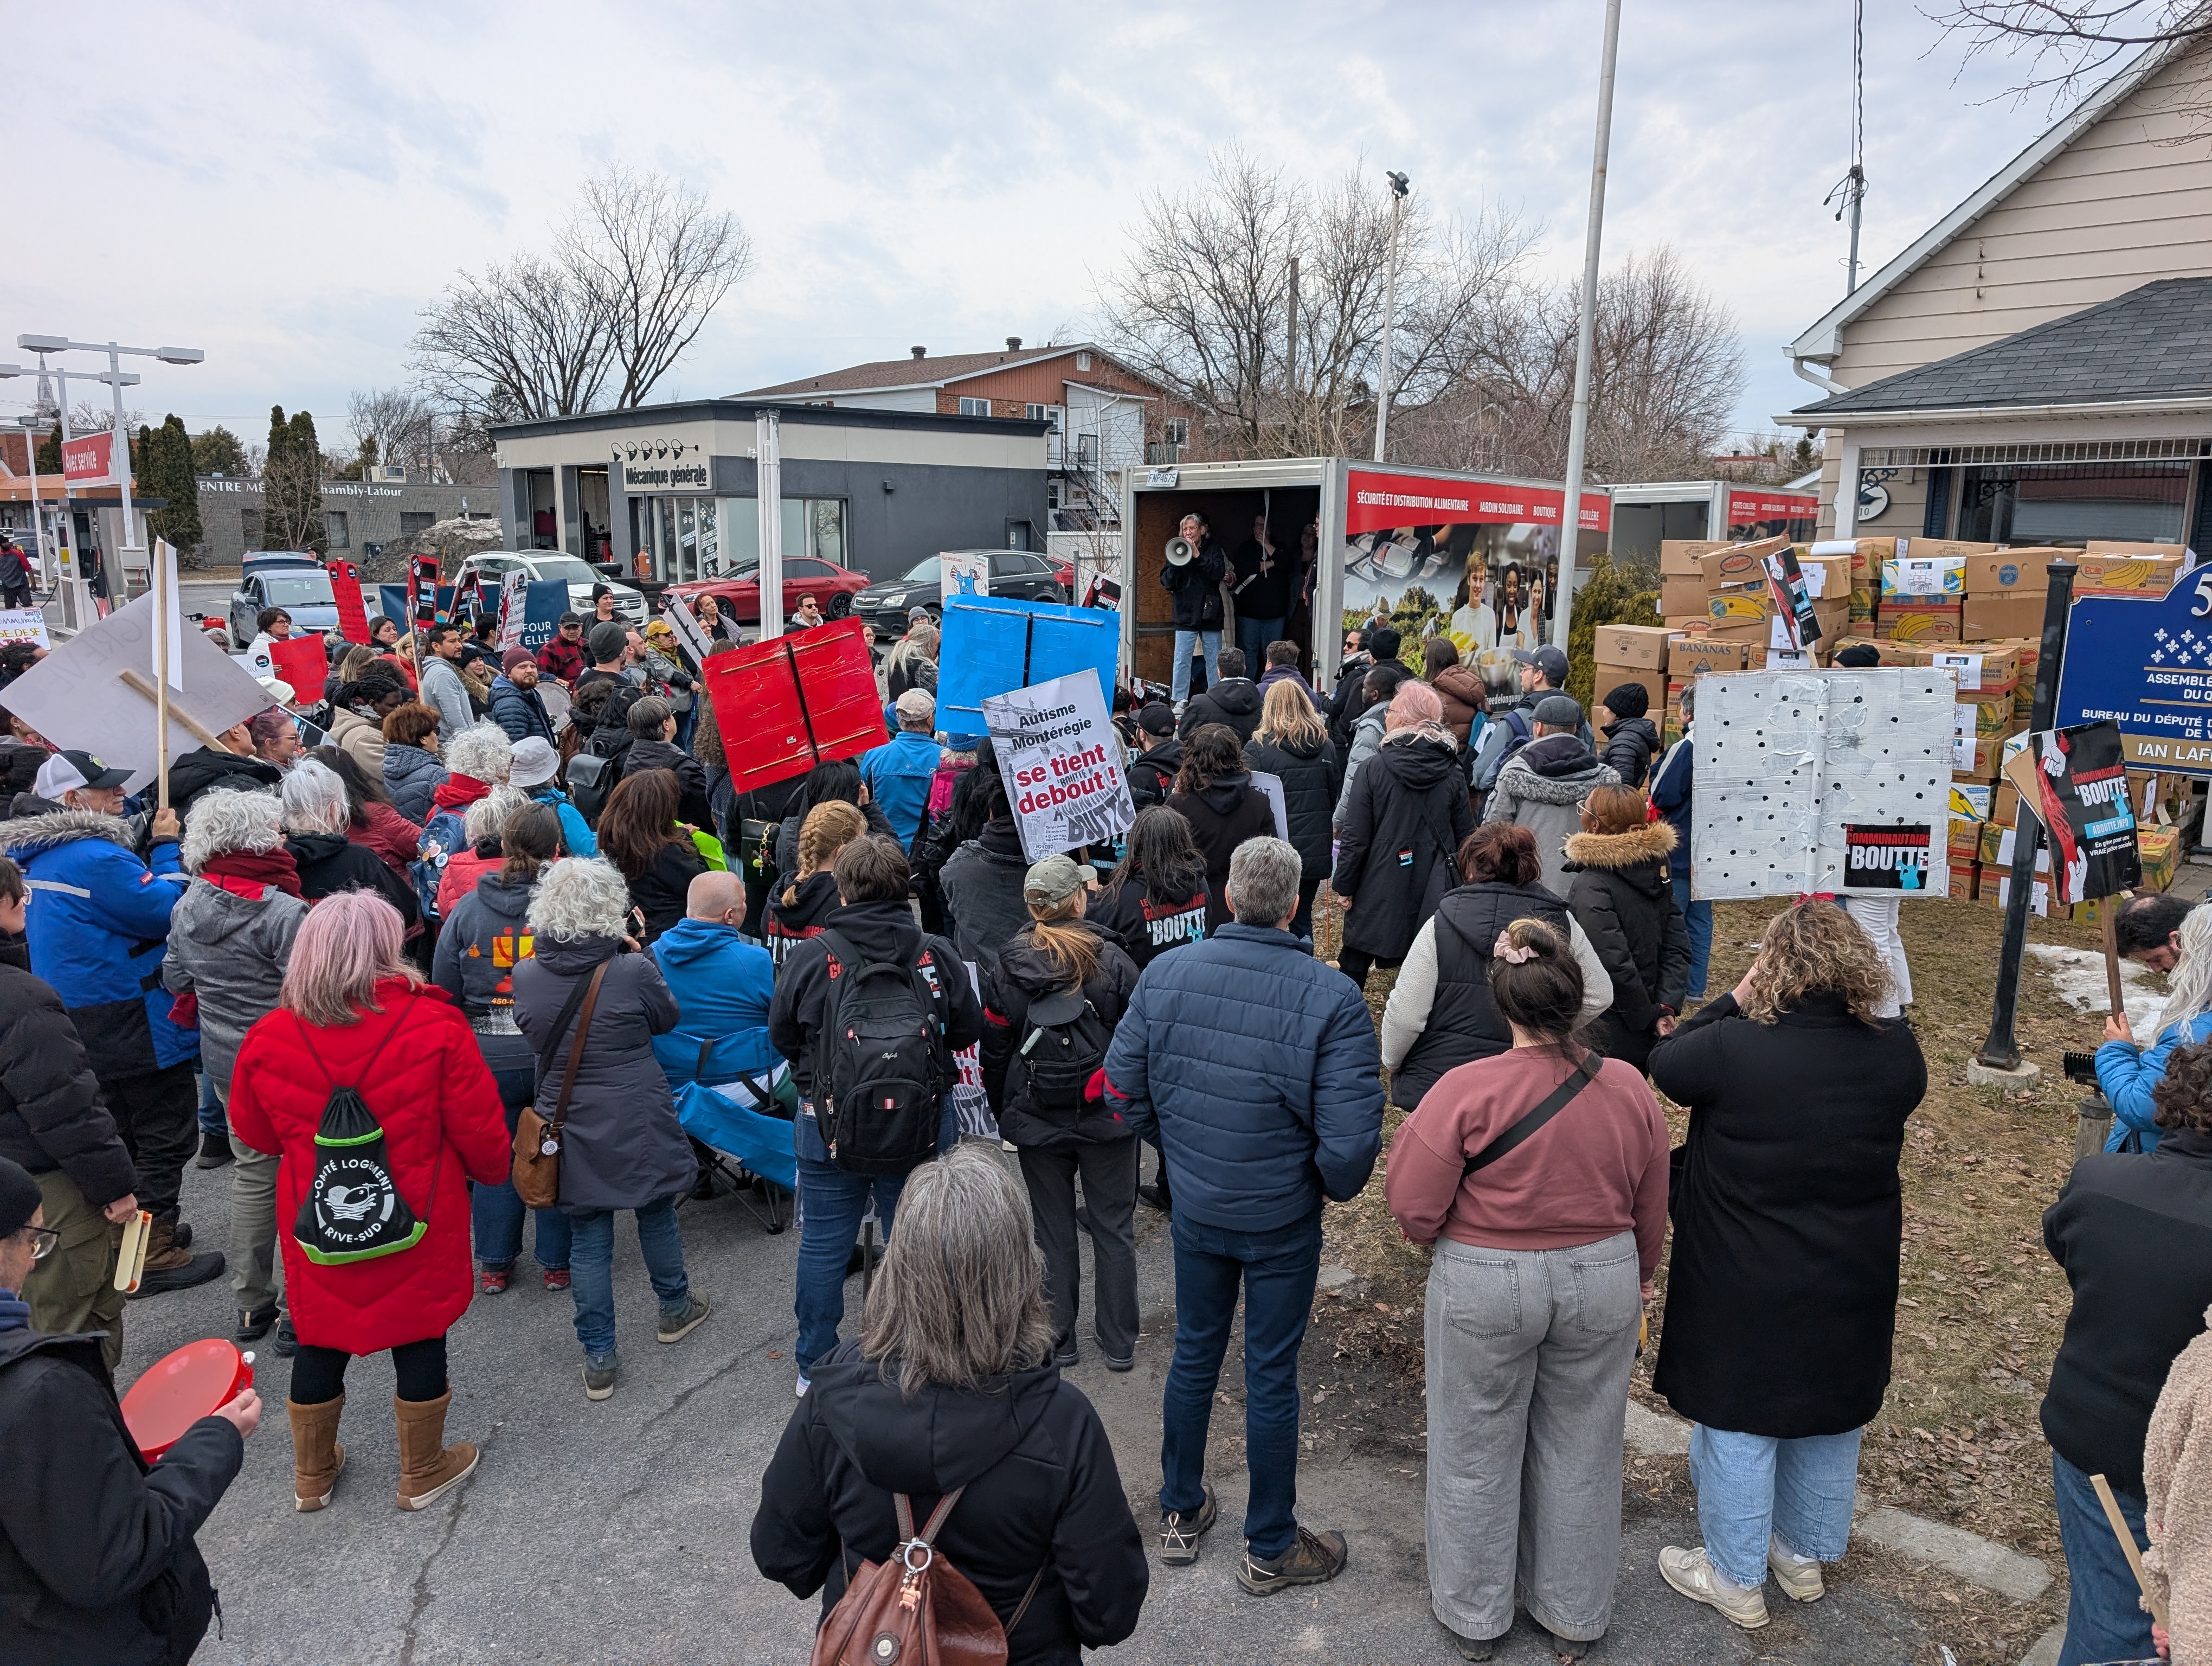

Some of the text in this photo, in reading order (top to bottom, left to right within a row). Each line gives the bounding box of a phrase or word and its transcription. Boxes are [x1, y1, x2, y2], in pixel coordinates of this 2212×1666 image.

[66, 445, 97, 472] Avec service
[625, 464, 707, 488] Mécanique générale
[1148, 473, 1176, 483] FNP4675
[196, 481, 402, 498] ENTRE MÉ hambly-Latour
[1357, 489, 1469, 511] SÉCURITÉ ET DISTRIBUTION ALIMENTAIRE
[1479, 501, 1523, 515] JARDIN SOLIDAIRE
[1533, 505, 1557, 518] BOUTIQUE
[1580, 509, 1599, 521] CUILLÈRE
[1860, 507, 1869, 516] 10
[681, 531, 696, 542] CHANGEMEN
[701, 537, 717, 549] RÉPARATIO
[2085, 566, 2101, 574] Dole
[1098, 597, 1117, 609] BOUTTE
[525, 634, 549, 645] ELLE
[1679, 643, 1731, 656] BANANAS
[2146, 673, 2212, 687] ASSEMBLÉ
[1485, 691, 1524, 706] iseedelongueuil
[2183, 688, 2202, 700] DU
[1019, 703, 1076, 729] Autisme
[2082, 709, 2129, 722] BUREAU
[2133, 712, 2151, 722] DU
[2155, 713, 2202, 727] DÉPUTÉ
[1012, 718, 1092, 751] Montérégie
[2185, 728, 2202, 738] DE
[2138, 742, 2212, 762] IAN LAF
[1017, 744, 1107, 787] se tient
[2071, 764, 2124, 785] COMMUNAUTAIRE
[1018, 766, 1117, 814] debout !
[2074, 776, 2129, 807] À BOUTTE
[2092, 818, 2129, 835] ABOUTTE.INFO
[1847, 832, 1930, 845] COMMUNAUTAIRE
[2113, 837, 2122, 845] pour
[1850, 845, 1929, 871] BOUTTE
[2089, 847, 2107, 856] VRAIE
[1140, 898, 1148, 907] LE
[1147, 906, 1206, 946] À BOUTTE
[342, 1159, 393, 1191] LOGEMENT
[324, 1222, 382, 1243] RIVE-SUD
